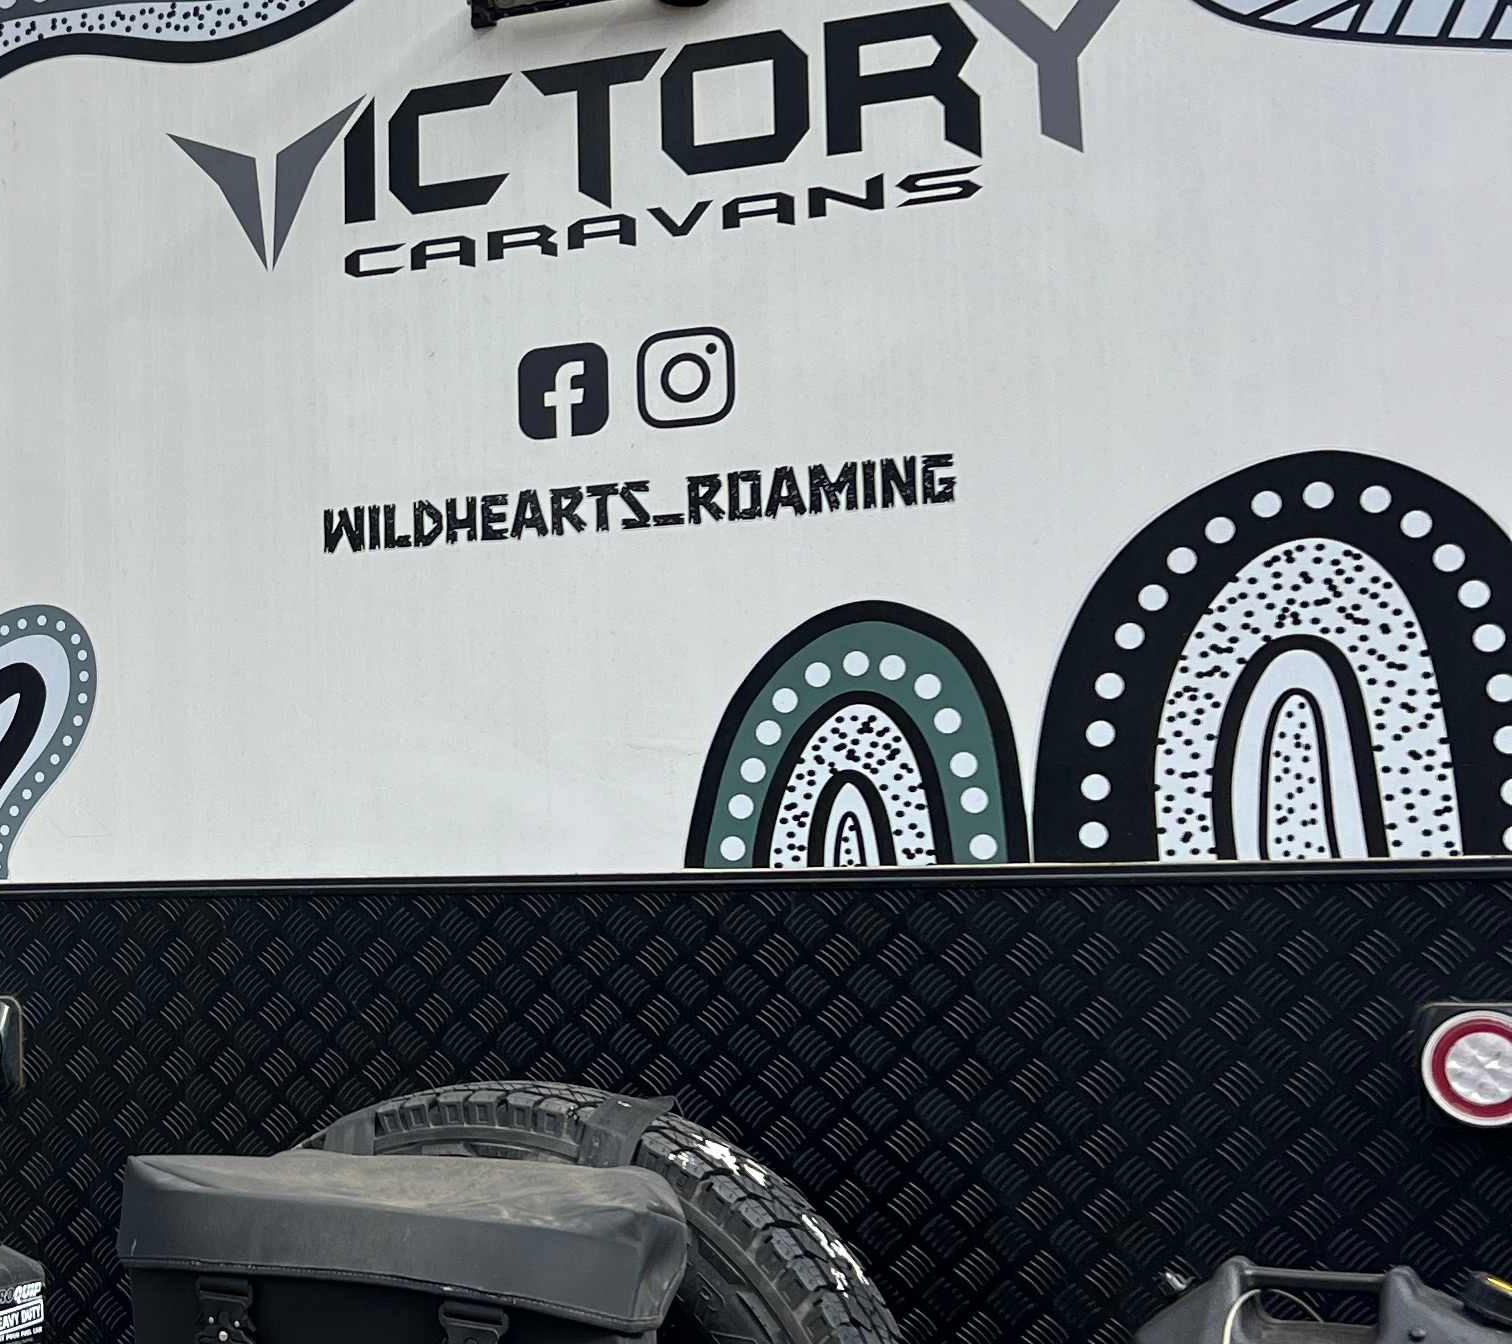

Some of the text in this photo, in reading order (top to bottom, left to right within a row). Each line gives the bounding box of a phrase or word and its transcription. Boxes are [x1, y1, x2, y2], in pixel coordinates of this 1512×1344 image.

[344, 165, 984, 278] CARAVANS
[323, 453, 957, 554] WILDHEARTS_ROAMING
[20, 1304, 42, 1323] DUTY
